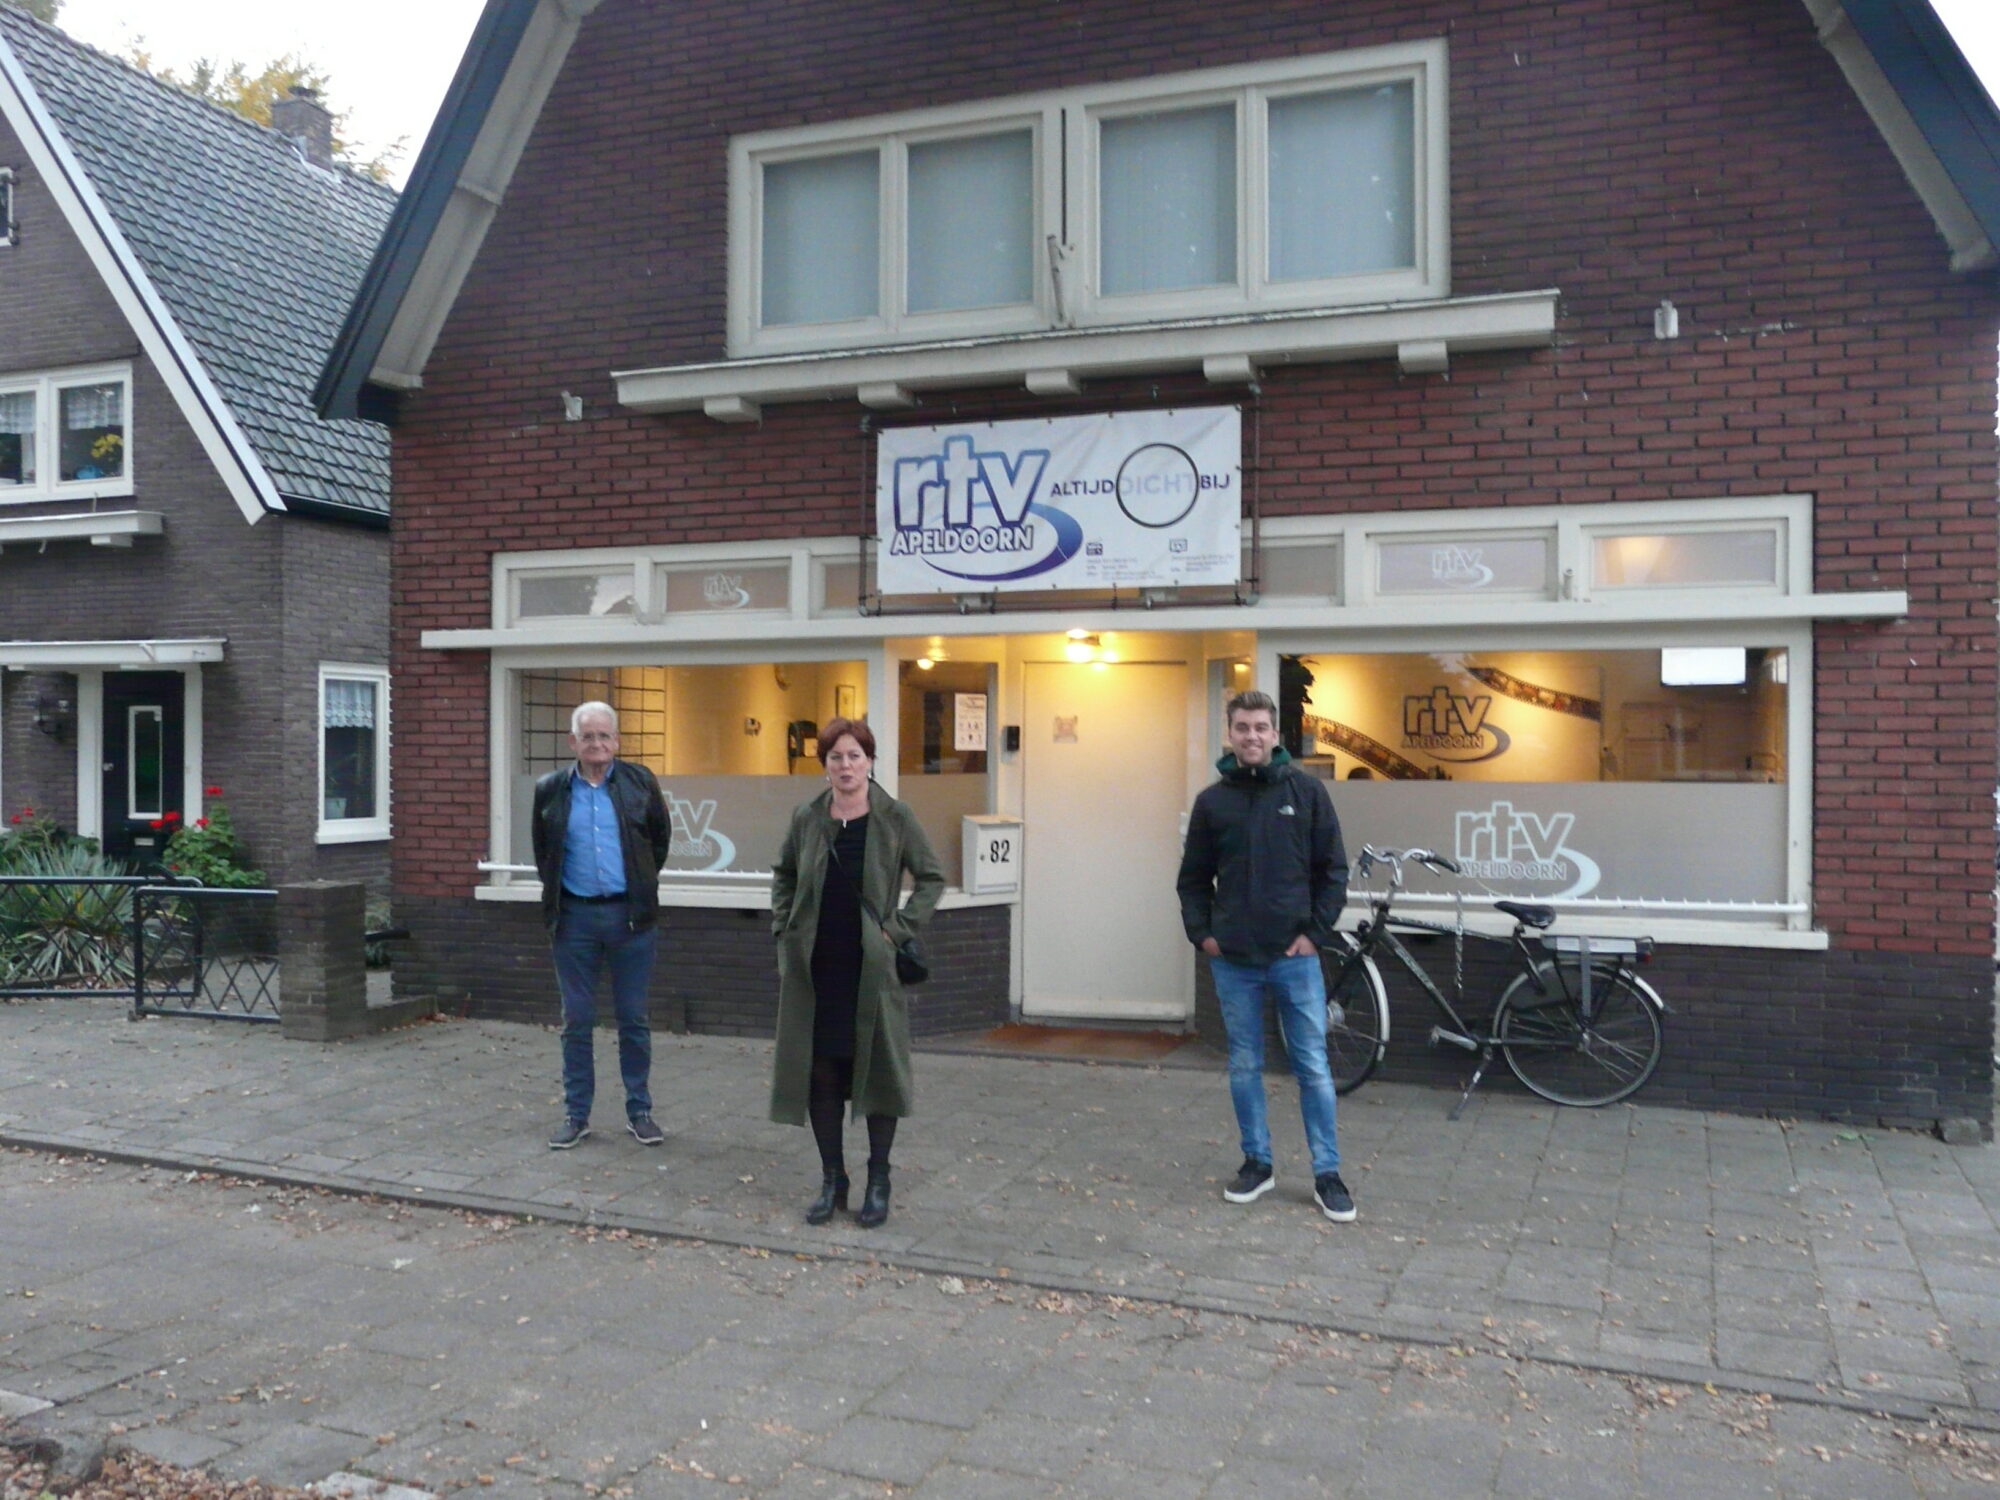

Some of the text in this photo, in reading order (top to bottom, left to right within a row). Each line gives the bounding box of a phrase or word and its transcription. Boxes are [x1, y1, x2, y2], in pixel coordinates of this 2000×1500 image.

[893, 434, 1051, 531] rtv
[1050, 479, 1115, 497] ALTIJD
[1200, 474, 1231, 490] BIJ
[890, 525, 1033, 555] APELDOORN
[1404, 686, 1492, 736] rtv
[990, 840, 1010, 863] 82
[1455, 800, 1575, 863] rtv
